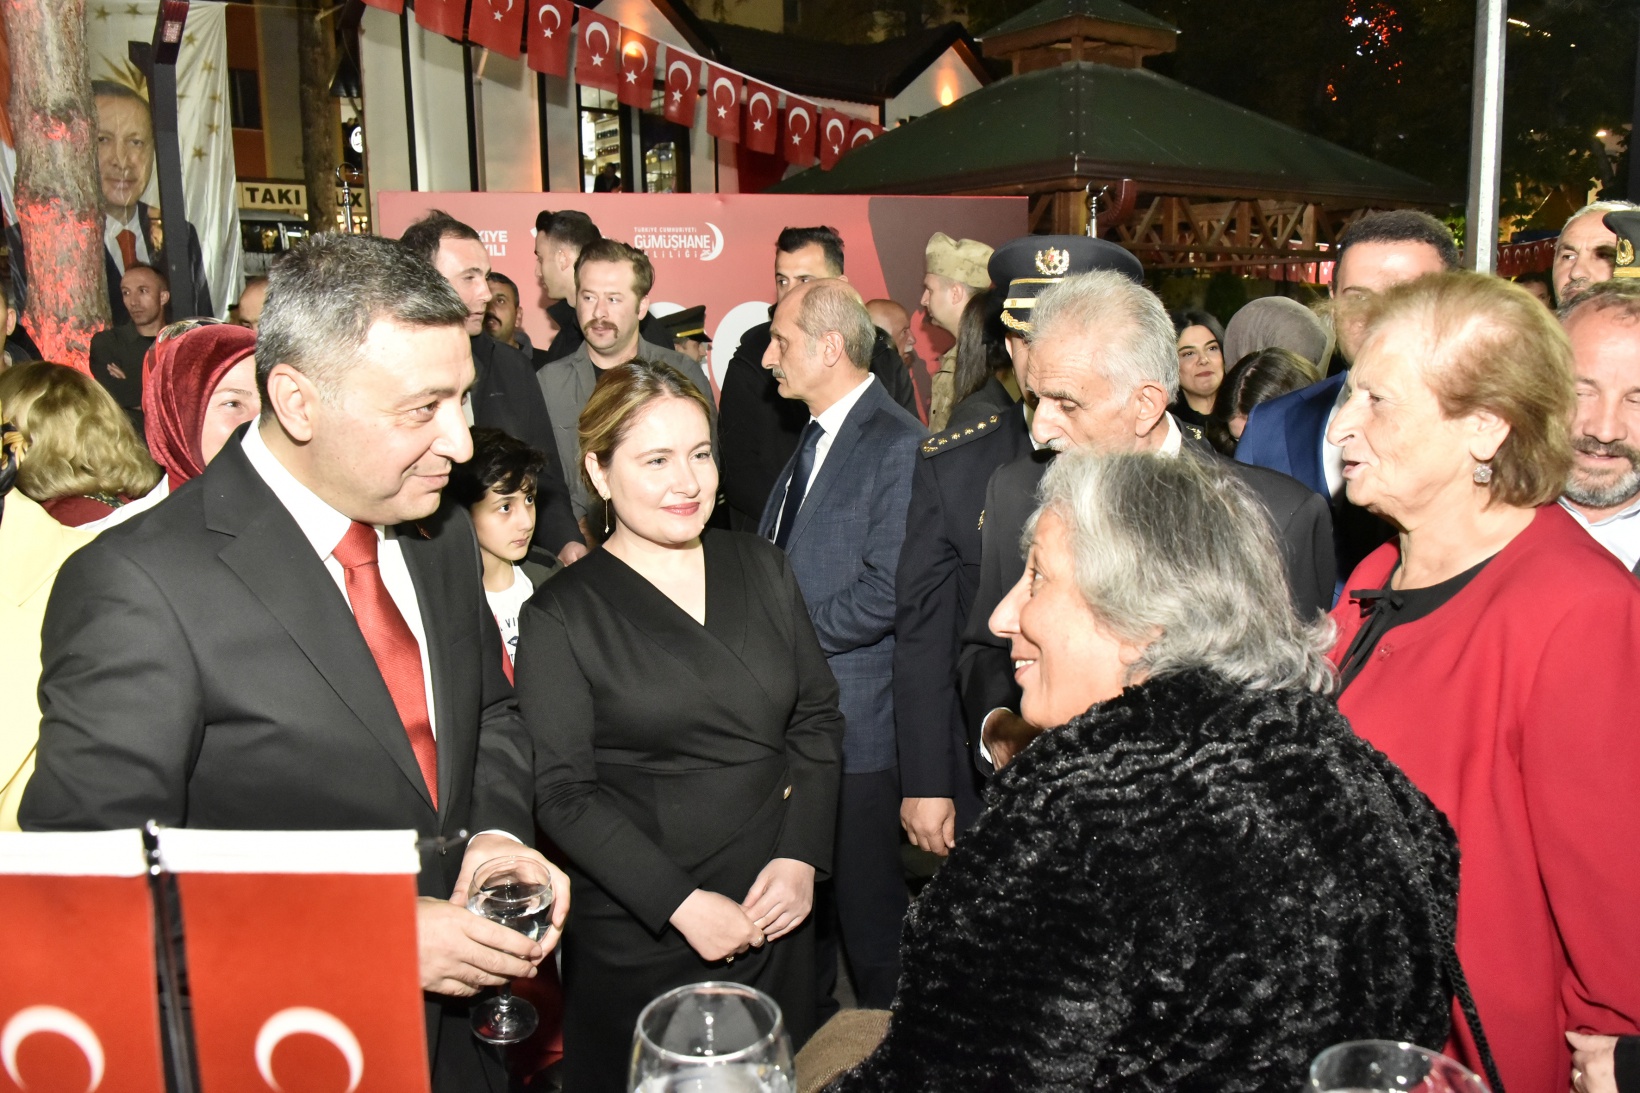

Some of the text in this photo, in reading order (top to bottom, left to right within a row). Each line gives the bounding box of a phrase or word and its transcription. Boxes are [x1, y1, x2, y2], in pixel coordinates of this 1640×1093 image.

[245, 187, 362, 208] TAKI UX
[634, 234, 711, 251] GÜMÜŞHANE
